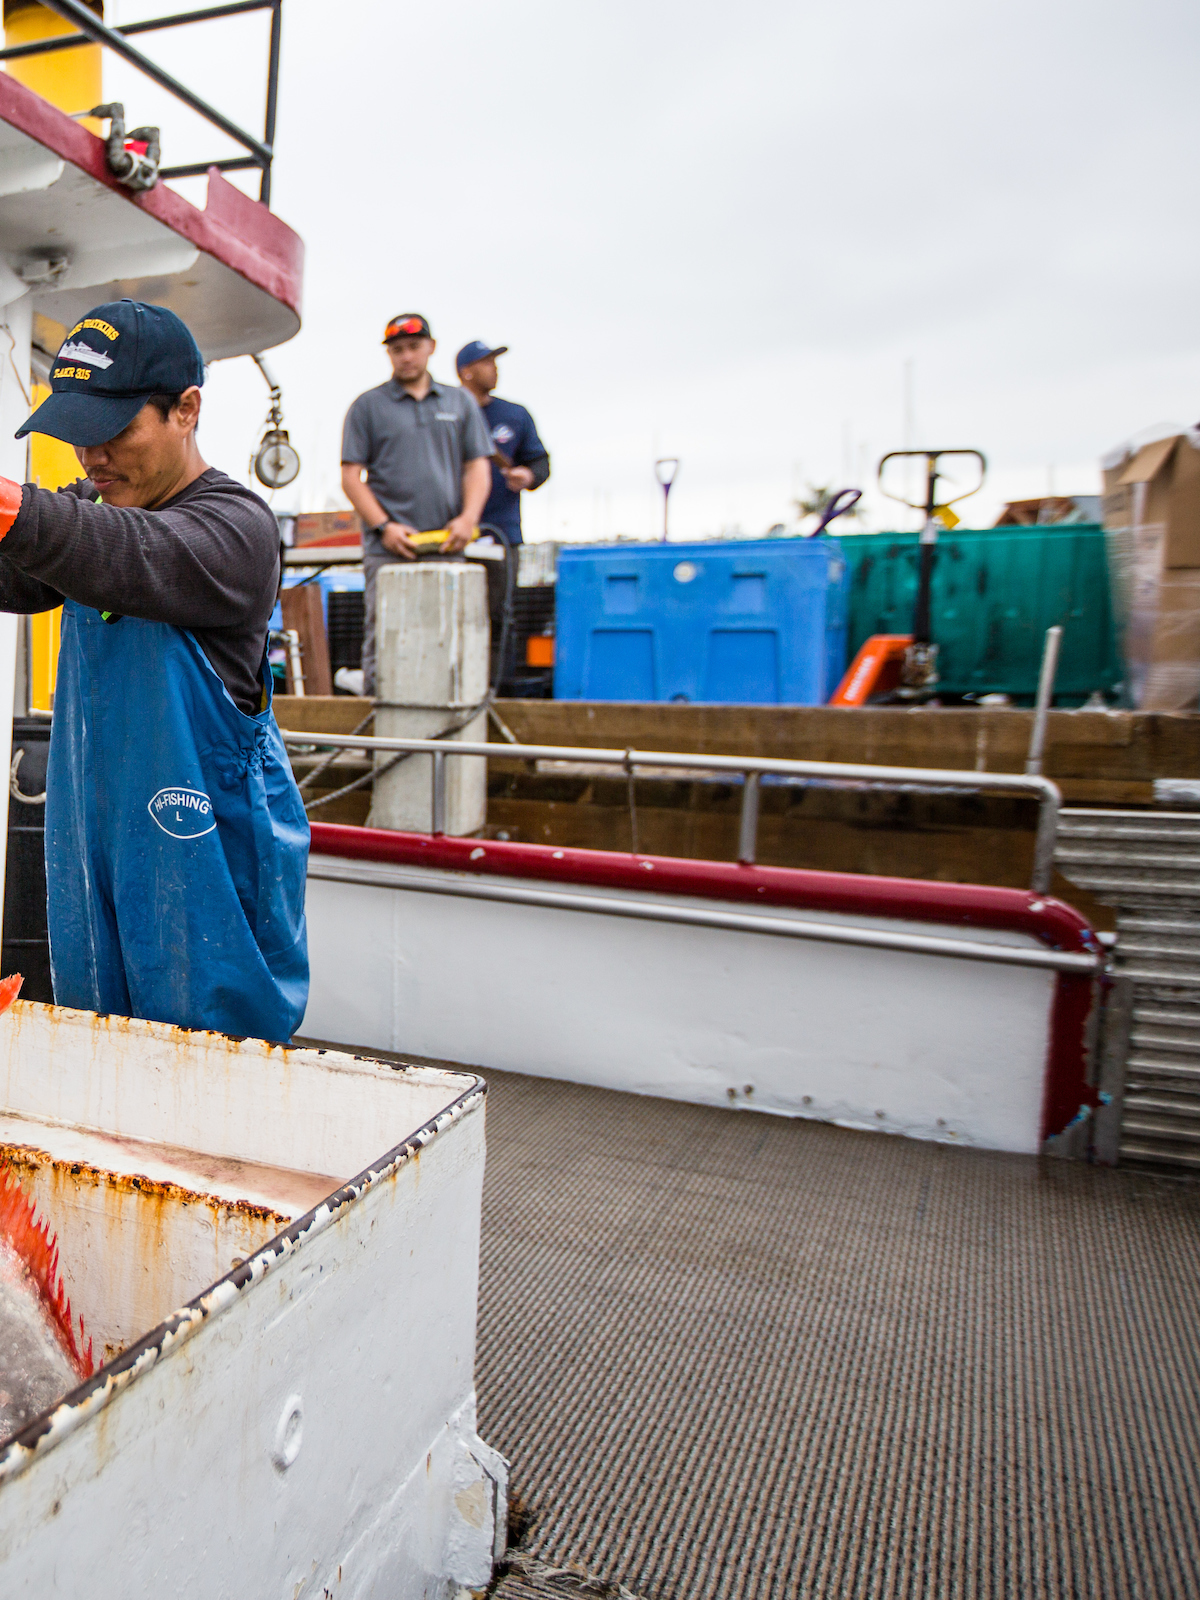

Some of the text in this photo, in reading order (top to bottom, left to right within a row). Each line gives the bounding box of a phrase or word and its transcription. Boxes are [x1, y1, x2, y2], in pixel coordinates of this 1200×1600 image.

[75, 367, 91, 380] 315
[154, 792, 209, 815] HI-FISHING
[176, 811, 183, 822] L
